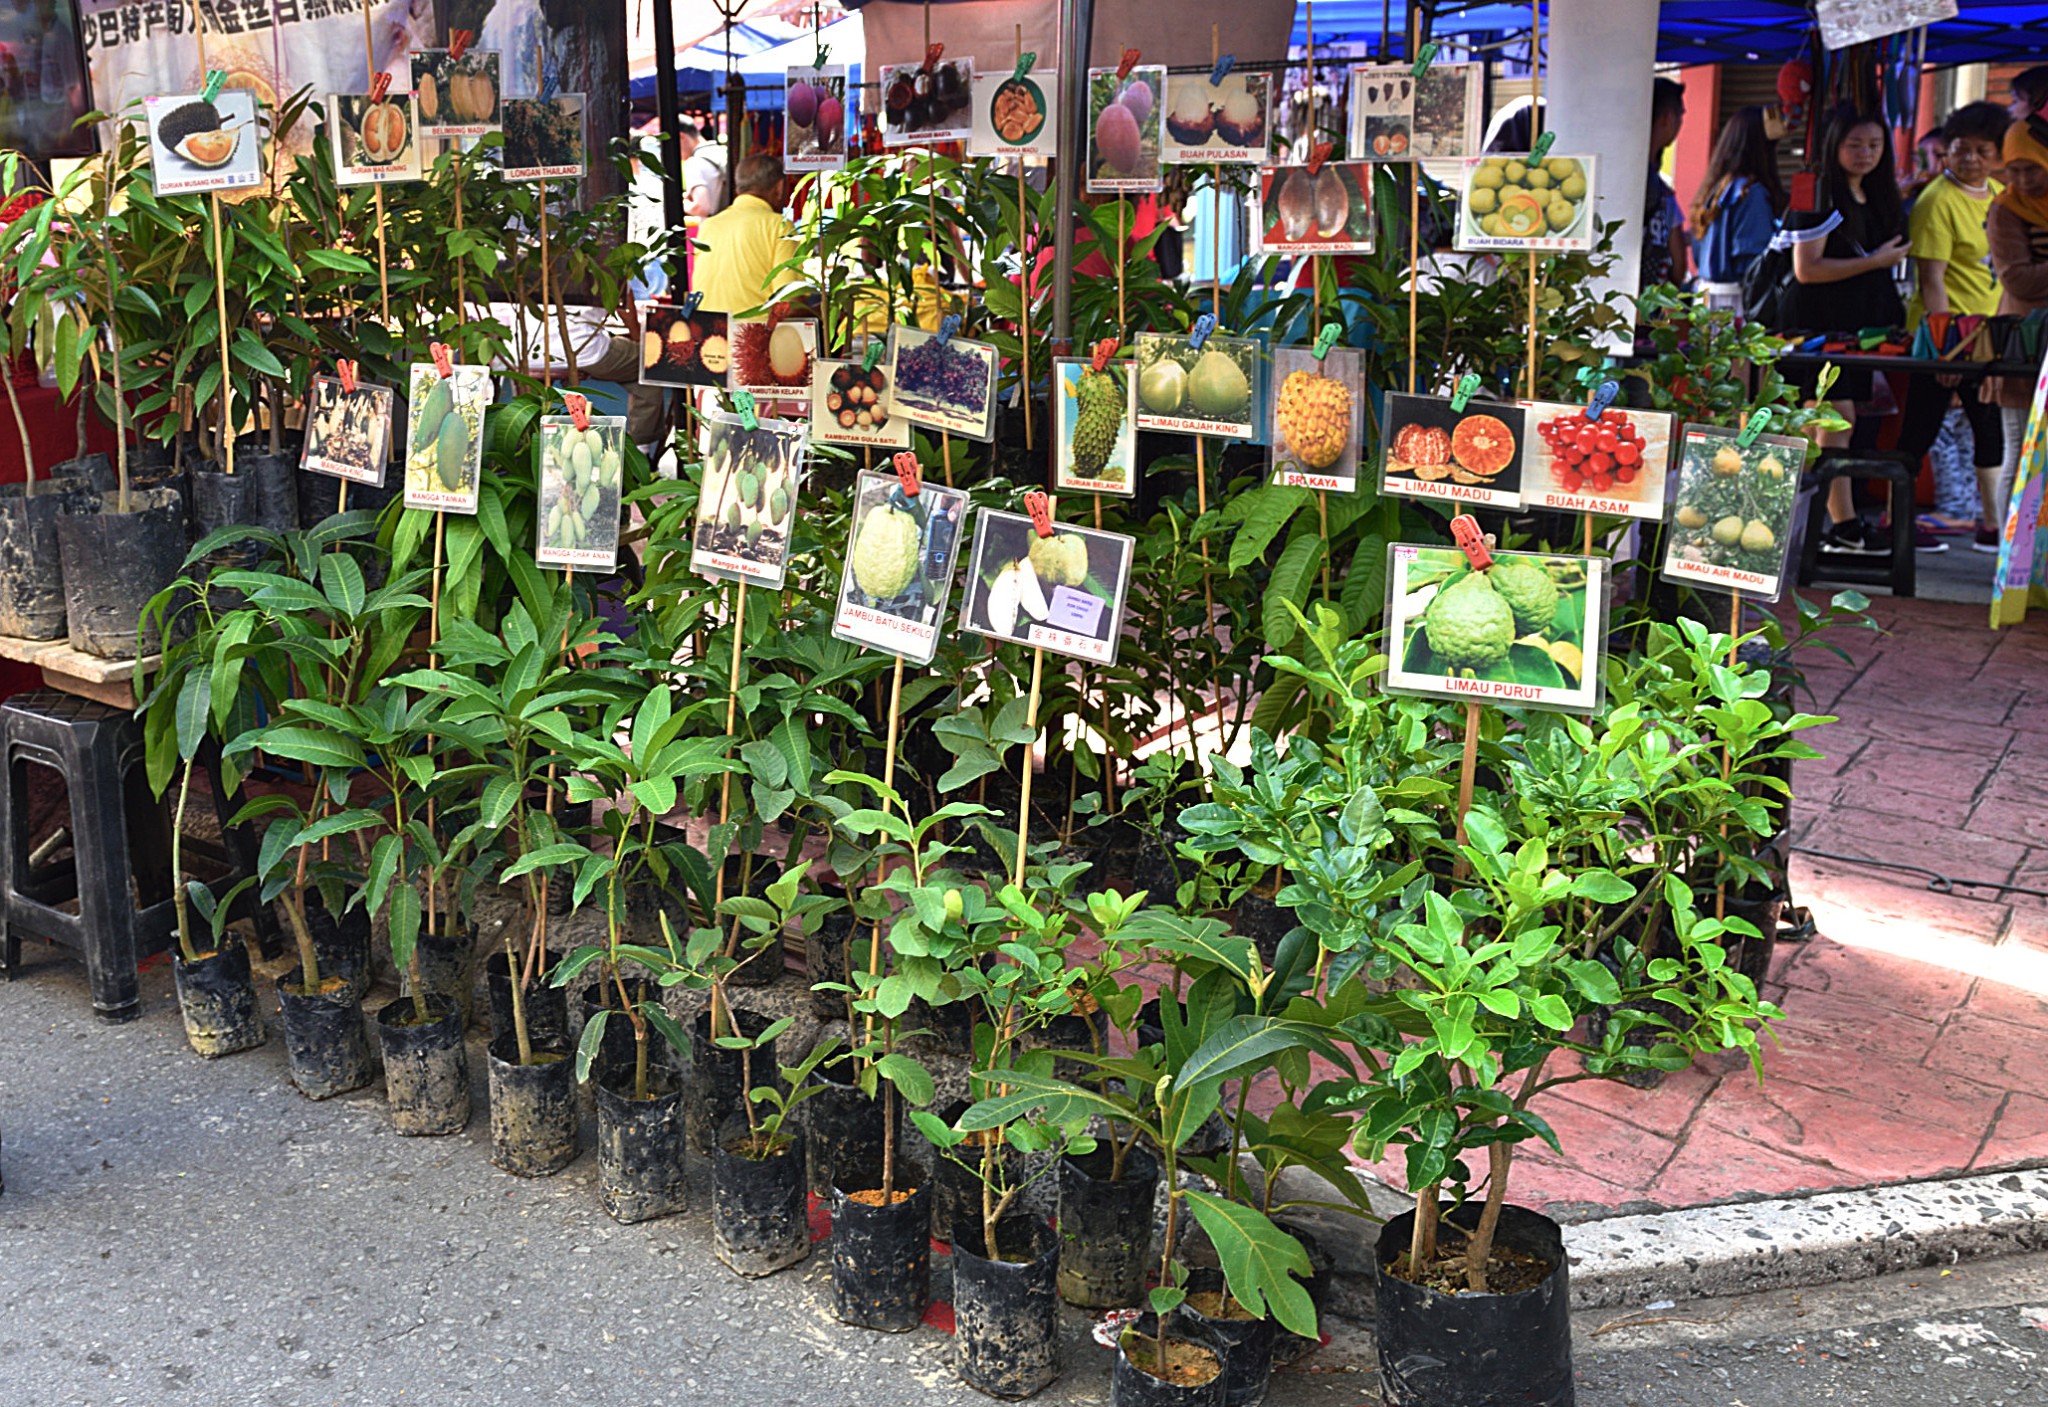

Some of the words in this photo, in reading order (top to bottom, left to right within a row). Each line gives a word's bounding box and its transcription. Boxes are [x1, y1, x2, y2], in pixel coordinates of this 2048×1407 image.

[432, 127, 465, 135] BELIMBING
[1180, 150, 1204, 158] BUAH
[1207, 150, 1248, 158] PULASAN
[373, 165, 386, 173] MAS
[511, 169, 541, 178] LONGAN
[543, 166, 577, 176] THAILAND
[161, 181, 182, 190] DURIAN
[185, 179, 209, 187] MUSANG
[1493, 238, 1524, 246] BIDARA
[912, 411, 944, 424] RAMBUTAN
[1151, 417, 1180, 428] LIMAU
[1182, 420, 1213, 431] GAJAH
[1215, 424, 1239, 434] KING
[825, 433, 860, 441] RAMBUTAN
[321, 461, 348, 473] MANGGA
[349, 467, 364, 478] KING
[1066, 478, 1091, 486] DURIAN
[1093, 481, 1124, 490] BELANDA
[1309, 477, 1338, 488] KAYA
[1405, 481, 1447, 495] LIMAU
[1451, 486, 1492, 501] MADU
[412, 493, 439, 502] MANGGA
[442, 495, 467, 504] TAIWAN
[1546, 494, 1585, 508] BUAH
[1589, 500, 1629, 514] ASAM
[543, 549, 570, 558] MANGGA
[711, 558, 739, 571] Mangga
[741, 564, 761, 574] Madu
[1677, 561, 1710, 575] LIMAU
[1712, 567, 1730, 579] AIR
[1732, 571, 1765, 585] MADU
[843, 607, 874, 623] JAMBU
[875, 615, 899, 630] BATU
[900, 622, 932, 639] SEKILO
[1446, 679, 1489, 695] LIMAU
[1494, 683, 1543, 700] PURUT
